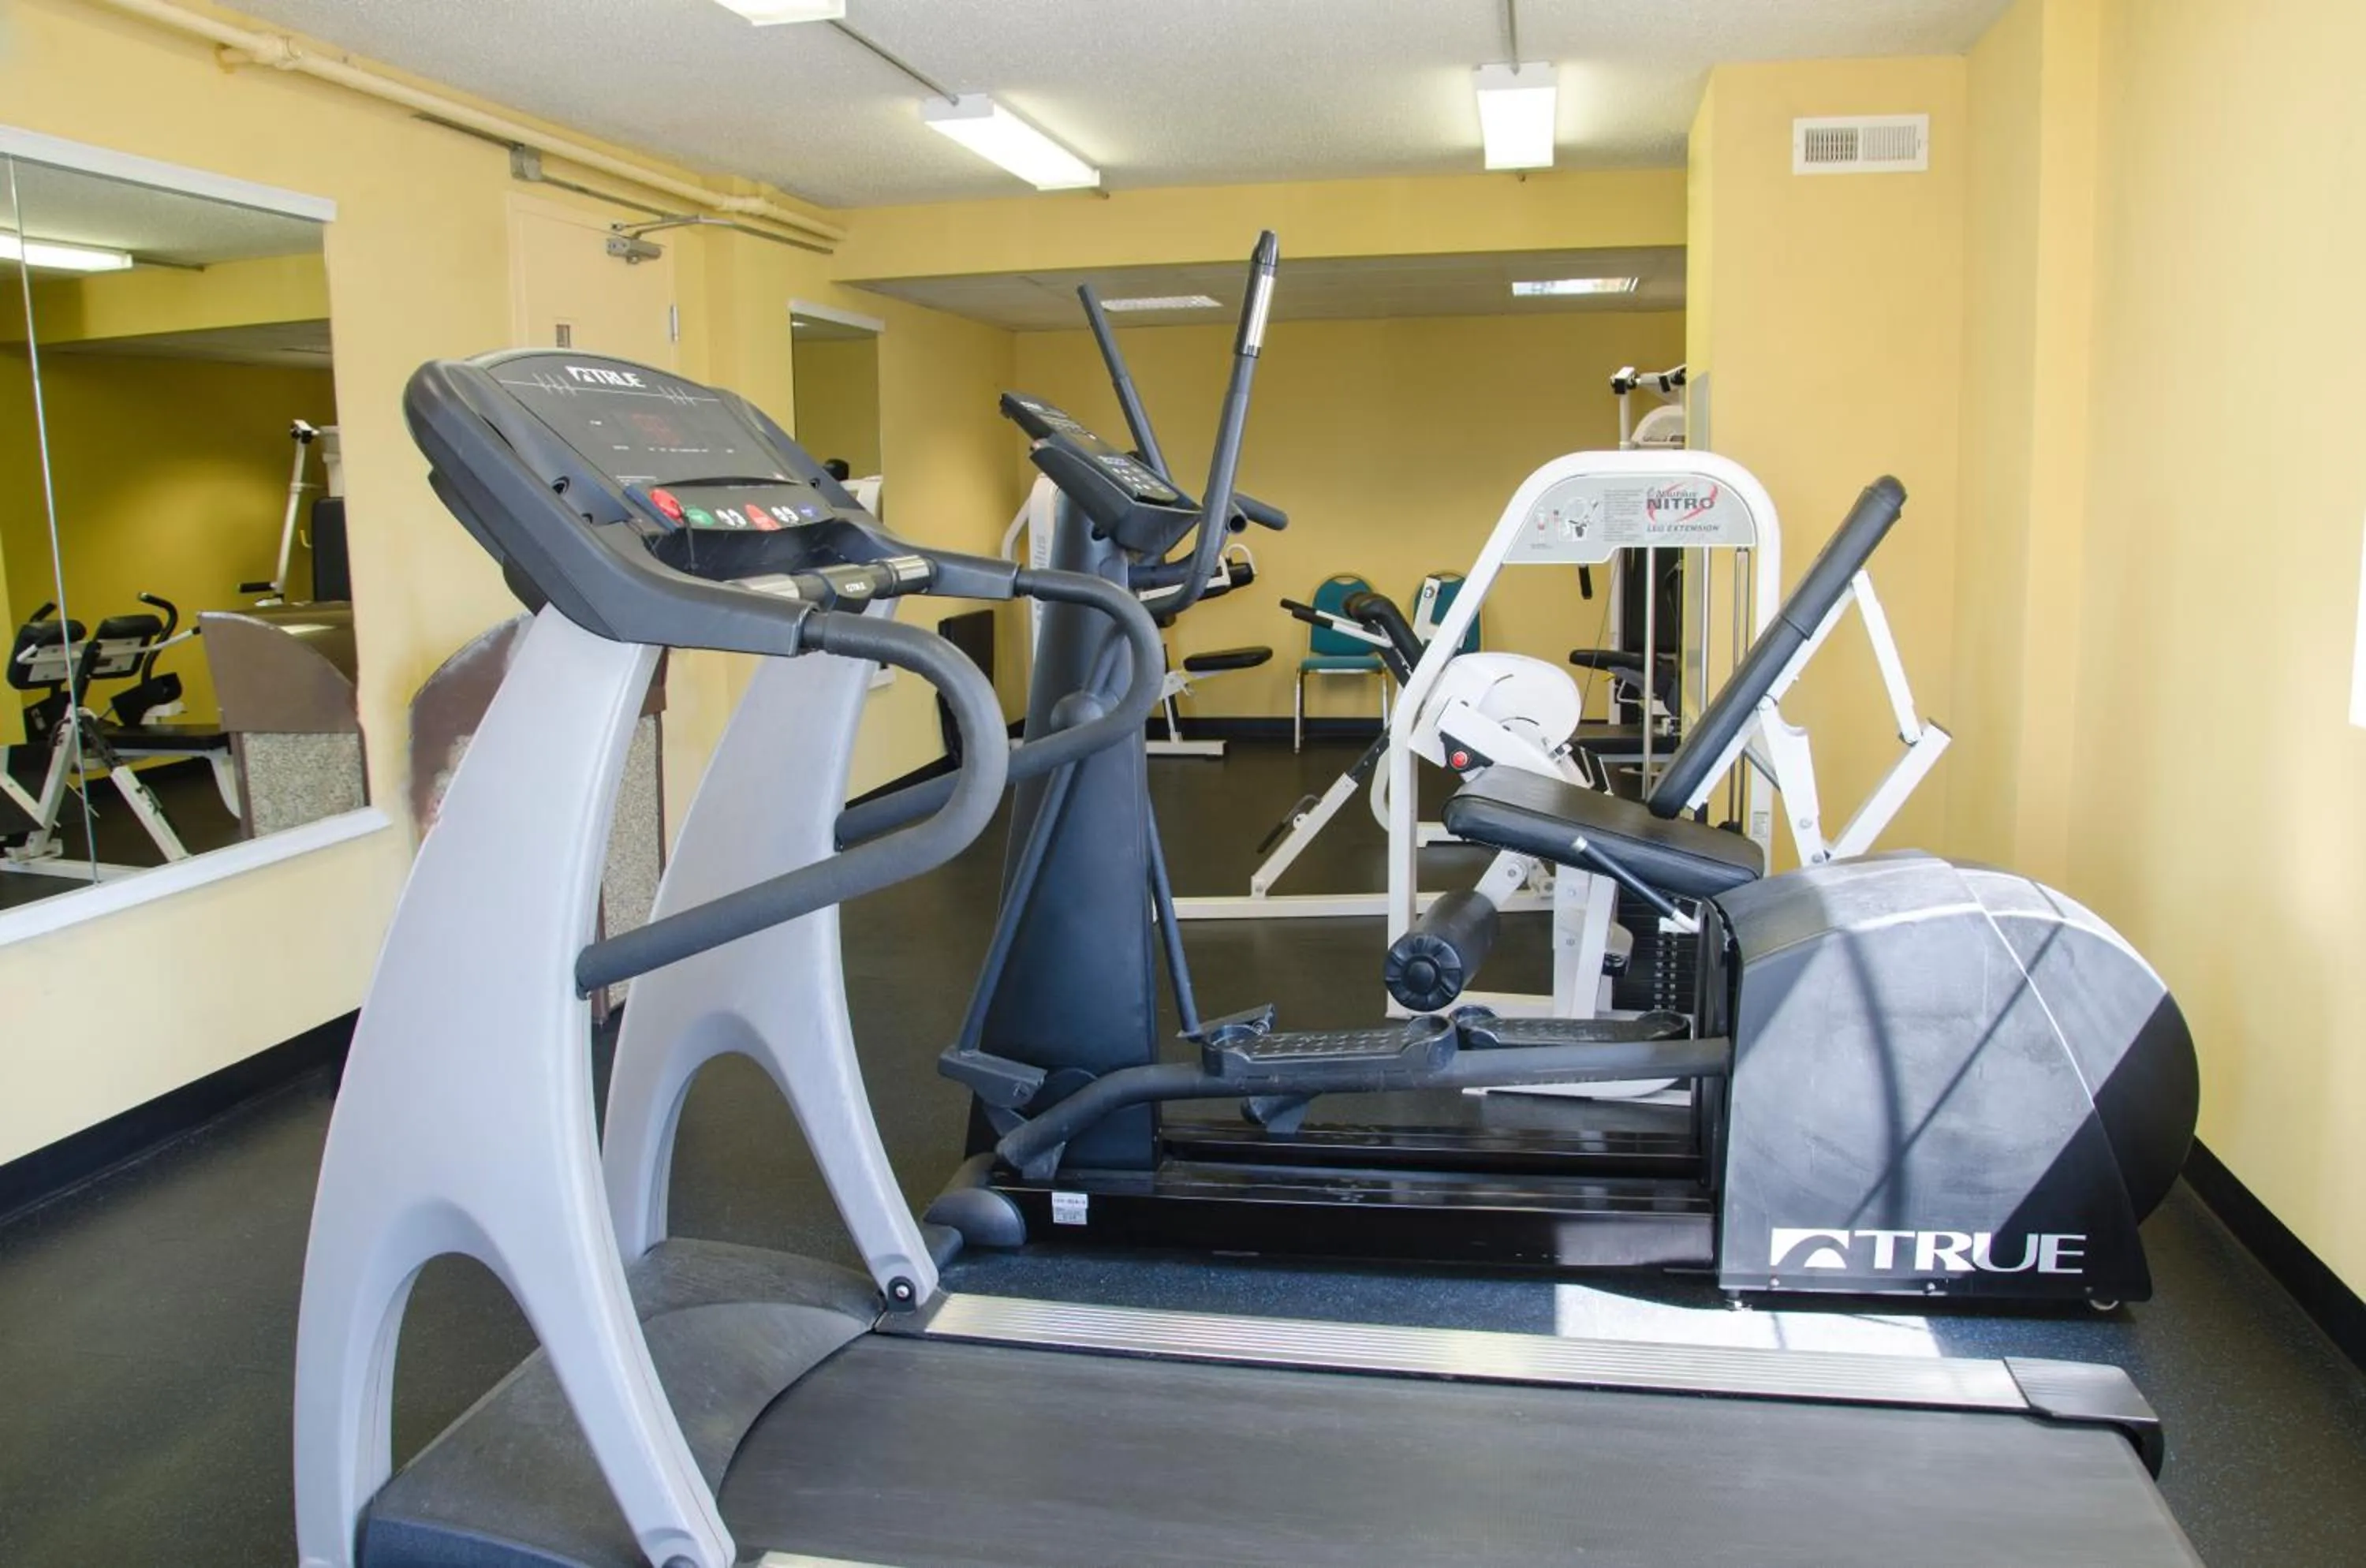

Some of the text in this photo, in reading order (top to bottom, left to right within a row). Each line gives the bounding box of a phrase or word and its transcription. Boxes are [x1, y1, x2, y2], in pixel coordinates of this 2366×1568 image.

[585, 368, 646, 388] TRUE
[1647, 497, 1715, 510] NITRO
[1854, 1229, 2087, 1275] TRUE
